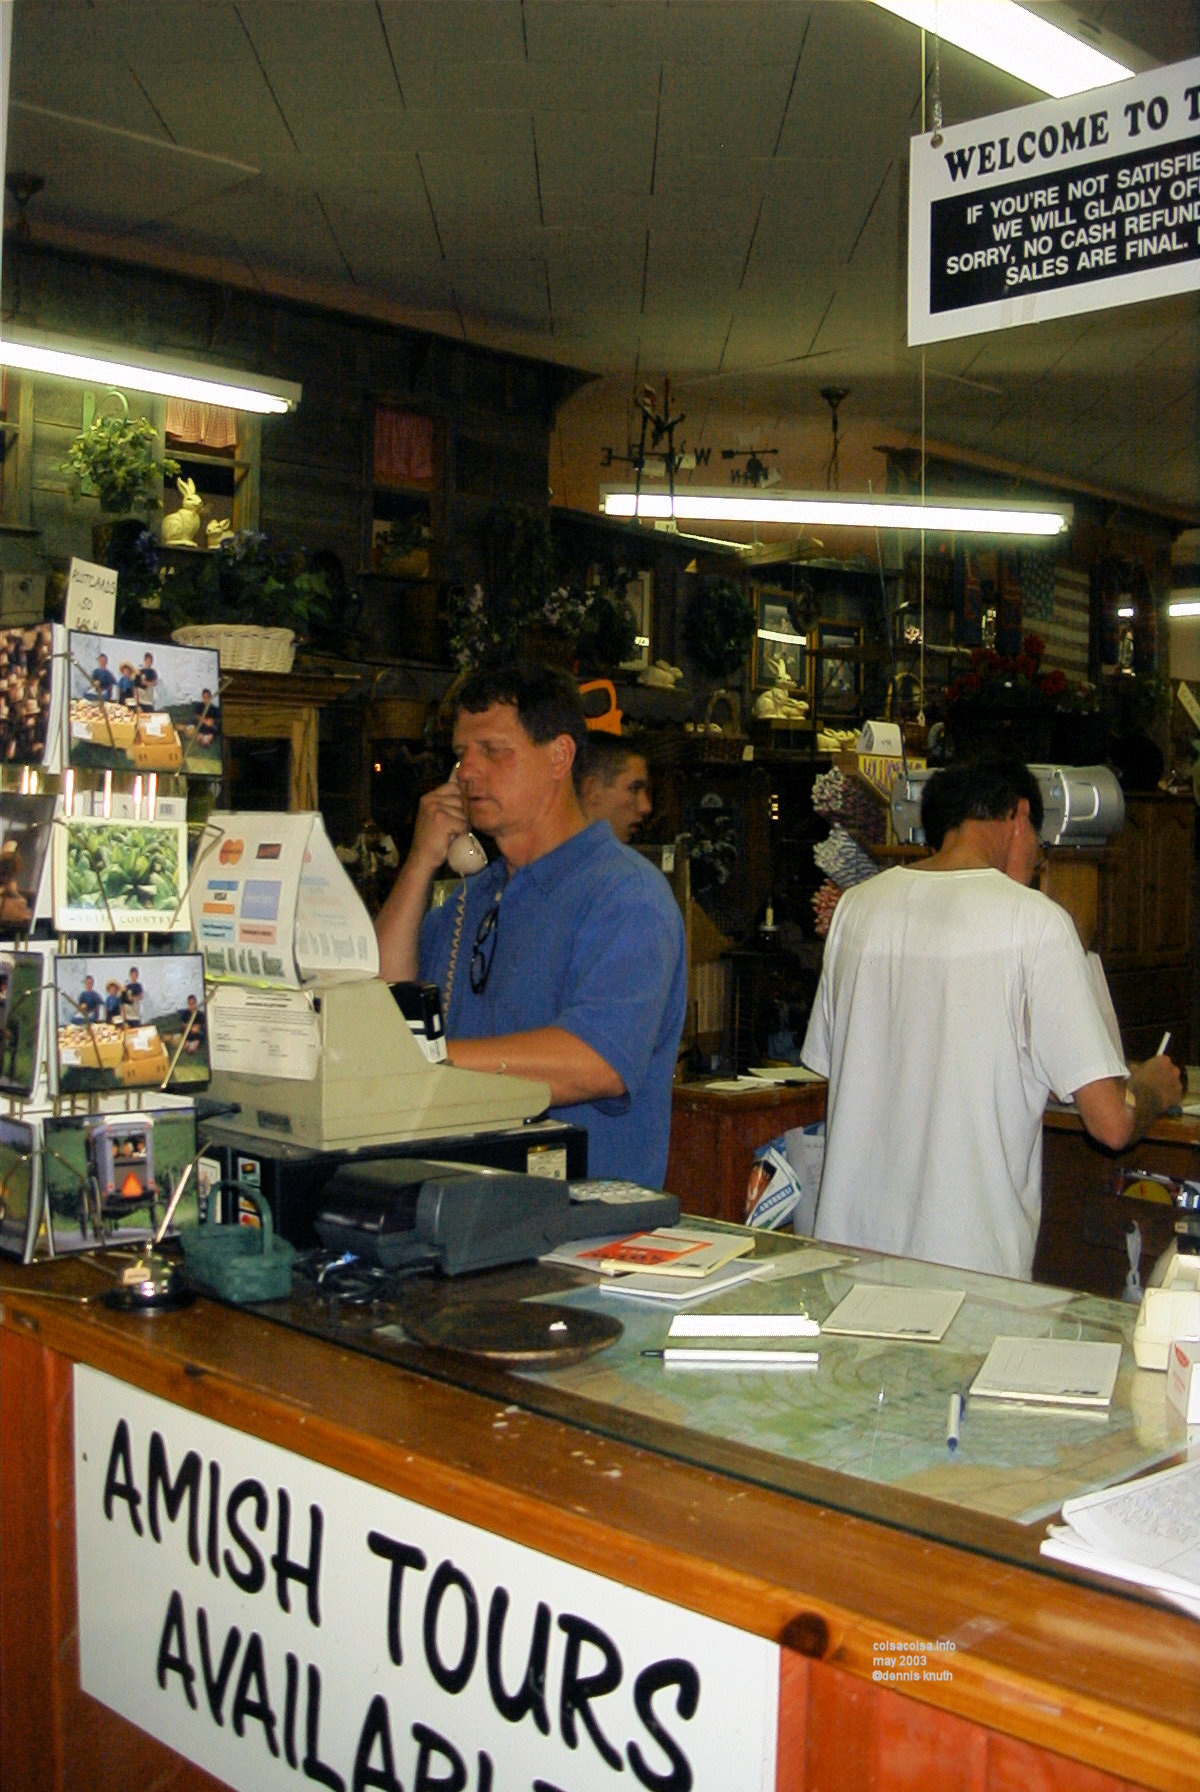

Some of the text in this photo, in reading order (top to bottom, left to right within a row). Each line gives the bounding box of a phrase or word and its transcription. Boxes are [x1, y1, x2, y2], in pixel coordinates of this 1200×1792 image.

[944, 111, 1109, 183] WELCOME
[1124, 95, 1169, 137] TO
[966, 204, 983, 225] IF
[990, 186, 1060, 217] YOU'RE
[1068, 174, 1110, 201] NOT
[992, 173, 1200, 242] WE WILL GLADLY OF
[946, 245, 1017, 275] SORRY,
[1024, 235, 1054, 257] NO
[1060, 221, 1117, 249] CASH
[1005, 255, 1069, 286] SALES
[1077, 245, 1118, 271] ARE
[1125, 233, 1189, 261] FINAL.
[103, 1418, 324, 1627] AMISH
[366, 1529, 702, 1792] TOURS
